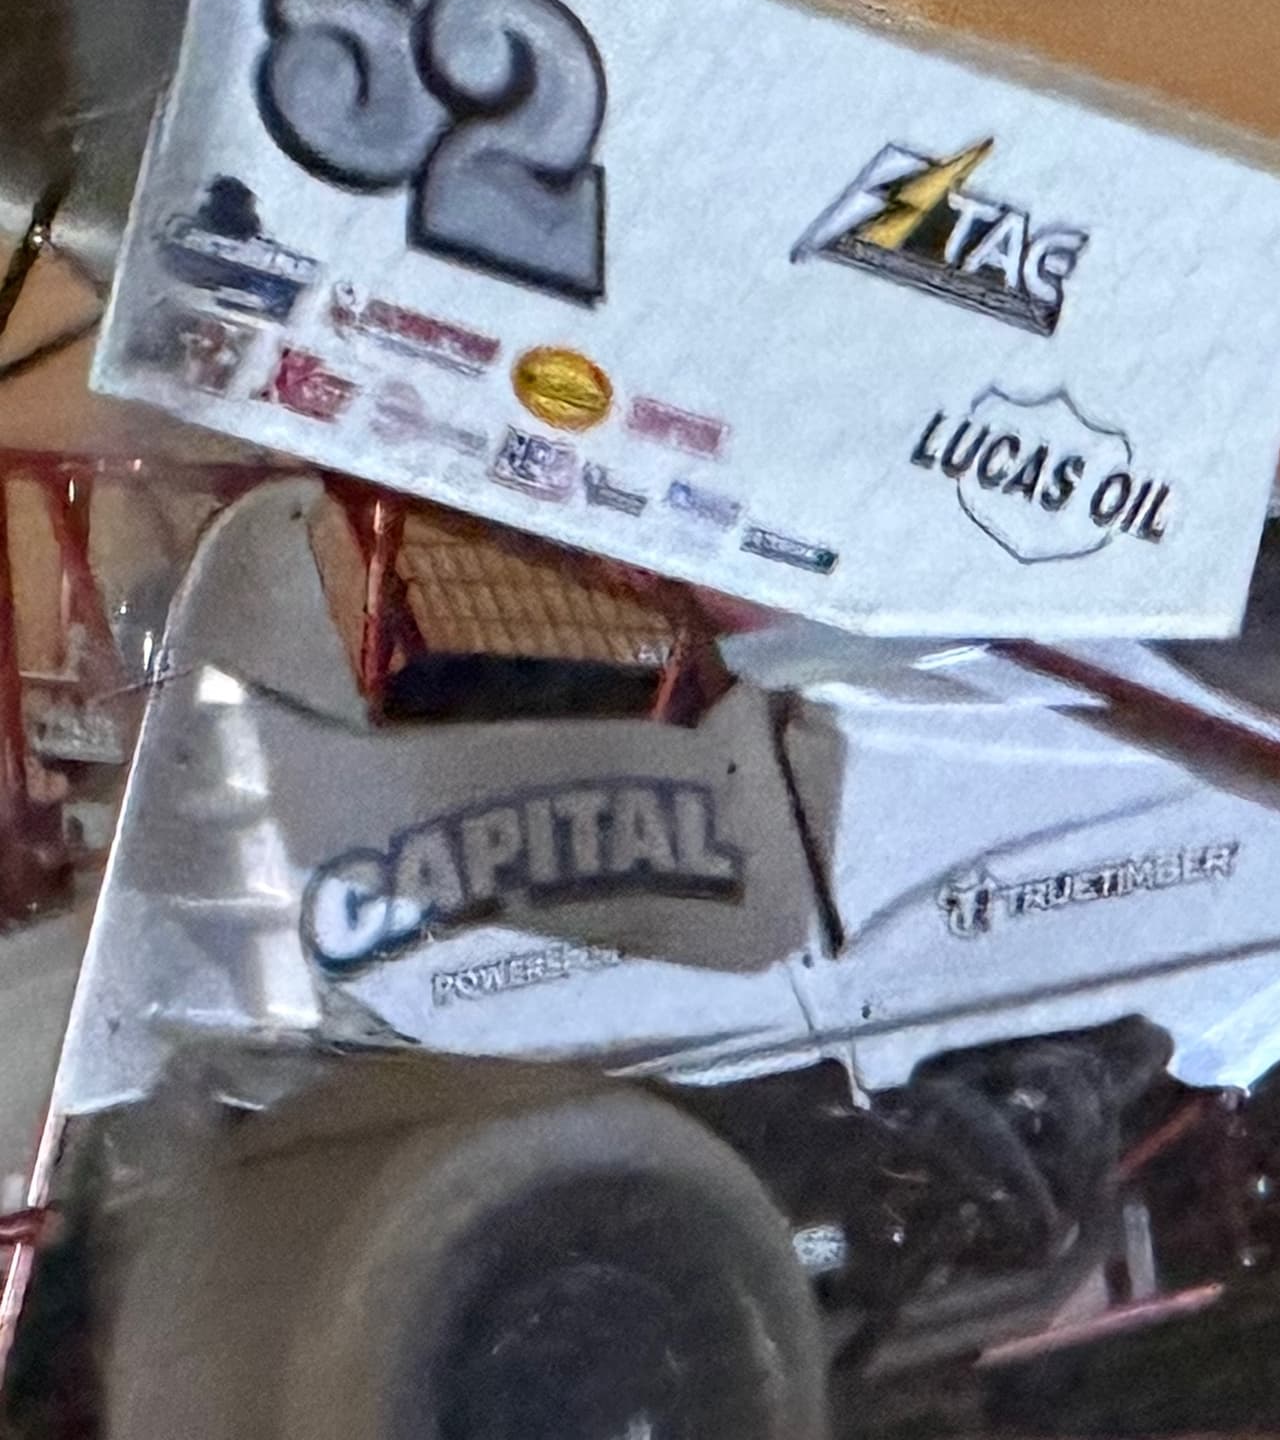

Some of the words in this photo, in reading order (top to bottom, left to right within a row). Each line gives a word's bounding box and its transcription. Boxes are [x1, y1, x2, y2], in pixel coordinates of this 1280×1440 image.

[909, 409, 1086, 513] LUCAS
[1088, 470, 1171, 545] OIL
[300, 774, 746, 978] CAPITAL
[1003, 840, 1240, 916] TRUETIMBER
